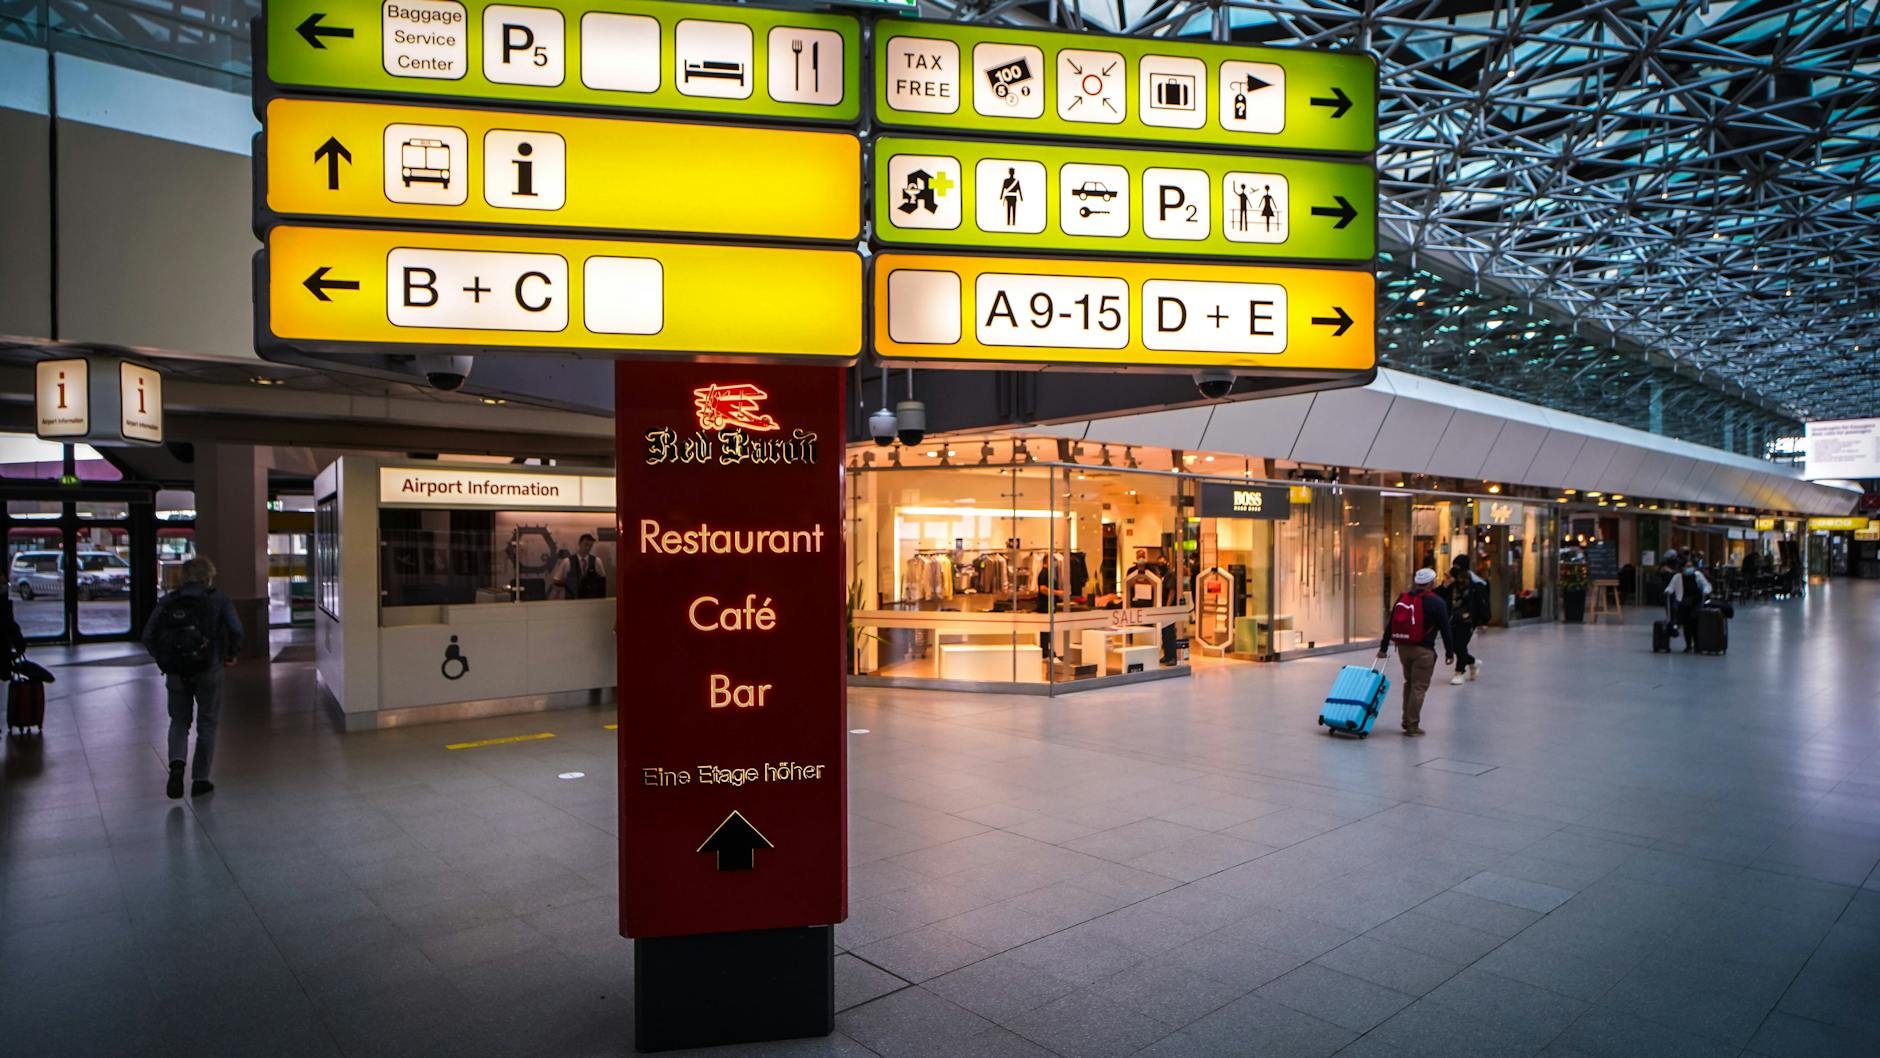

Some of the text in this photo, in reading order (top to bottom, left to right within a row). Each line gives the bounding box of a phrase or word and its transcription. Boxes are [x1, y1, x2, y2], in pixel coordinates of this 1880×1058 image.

[388, 4, 462, 25] Baggage
[394, 29, 456, 47] Service
[397, 54, 454, 71] Center
[904, 52, 943, 71] TAX
[994, 64, 1022, 83] 100
[896, 79, 951, 98] FREE
[402, 266, 553, 313] B + C
[985, 289, 1122, 331] A 9-15
[1157, 295, 1275, 337] D + E
[645, 427, 818, 465] Red Baron
[401, 477, 560, 497] Airport Information
[1233, 490, 1262, 507] BOSS
[640, 519, 825, 555] Restaurant
[688, 594, 777, 632] Café
[1112, 609, 1143, 626] SALE
[710, 673, 773, 709] Bar
[642, 761, 826, 788] Eine Etage höher
